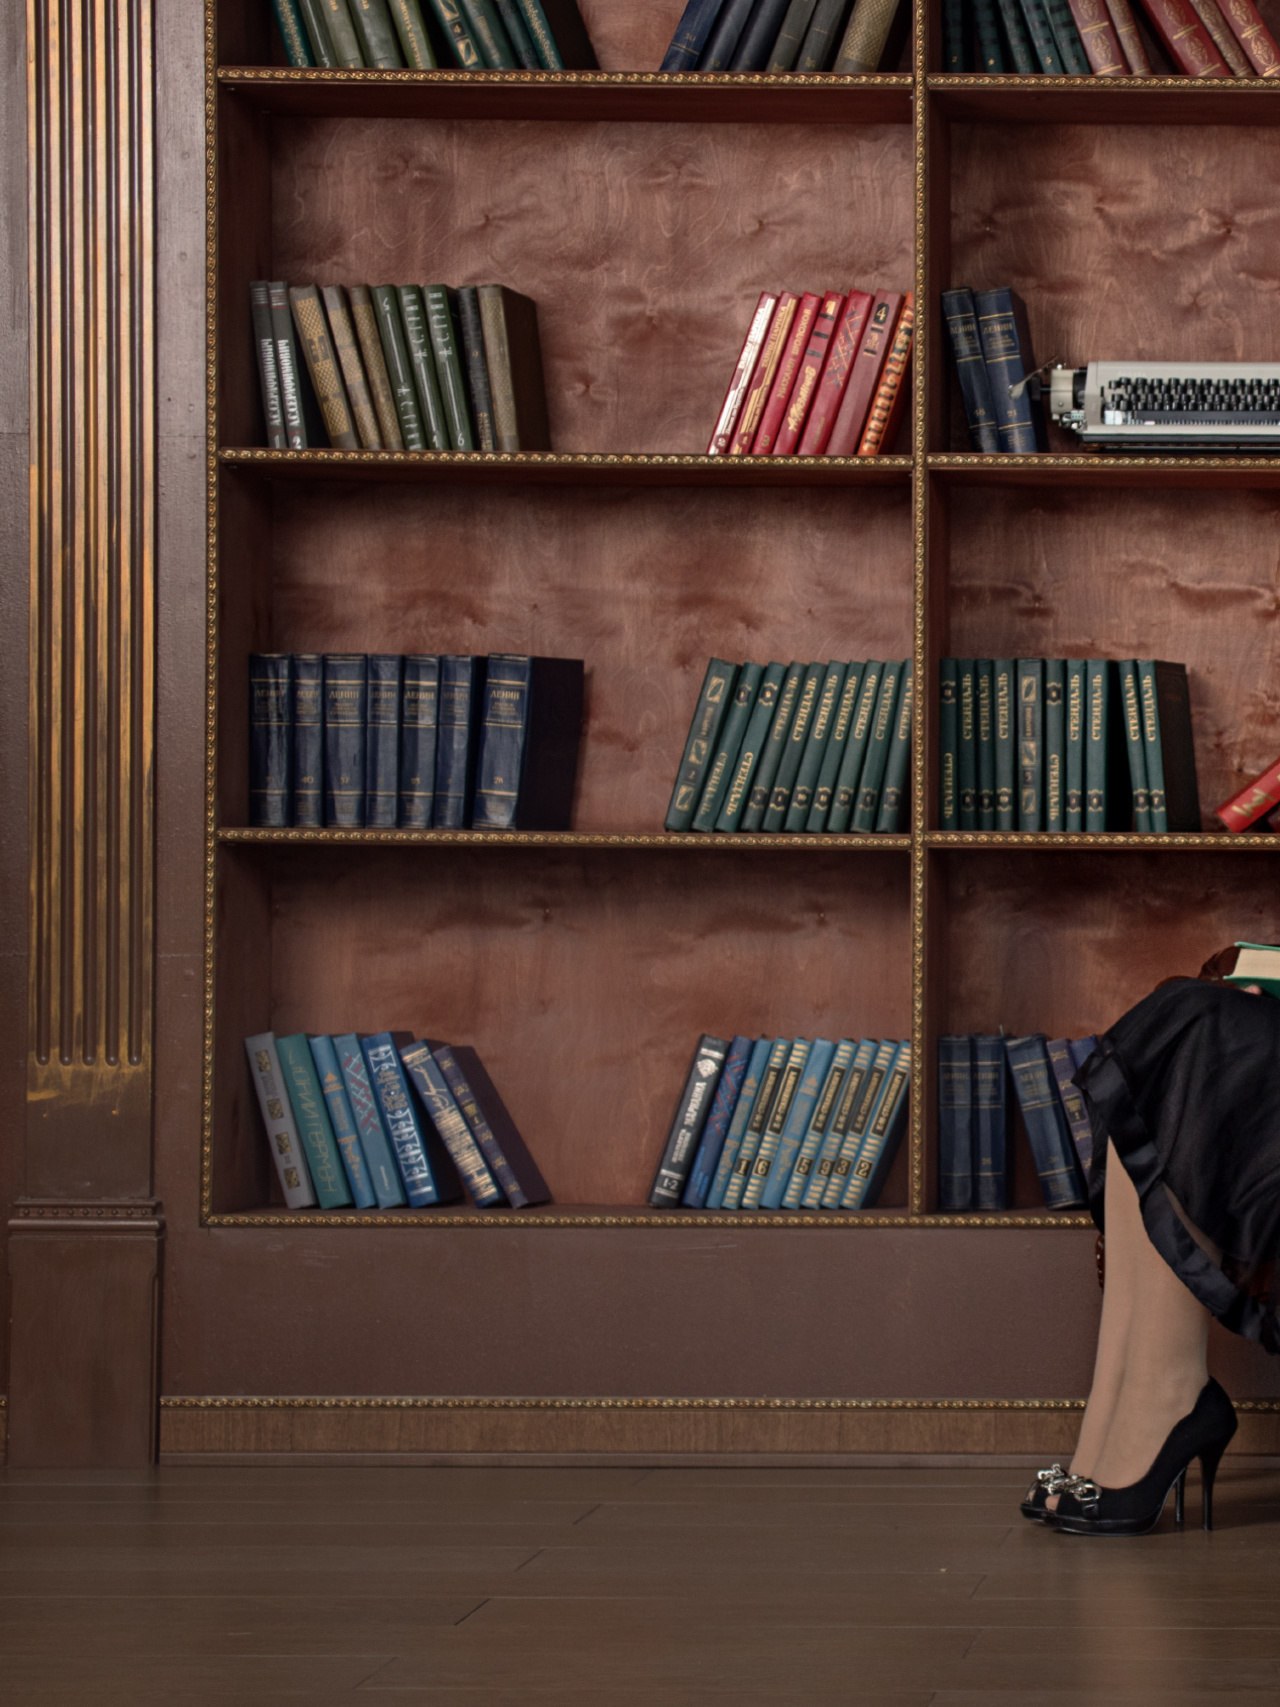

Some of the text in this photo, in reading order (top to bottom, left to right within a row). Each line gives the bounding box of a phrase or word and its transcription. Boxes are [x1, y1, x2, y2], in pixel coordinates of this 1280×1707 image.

[791, 309, 811, 355] ШОЛОХОВ
[877, 306, 886, 321] 4
[292, 435, 301, 449] 2
[457, 433, 464, 446] 6
[329, 690, 360, 700] ЛЕНИН
[405, 691, 435, 701] ЛЕНИН
[490, 691, 520, 700] ЛЕНИН
[773, 676, 798, 740] СТЕНДАЛЬ
[793, 677, 817, 741] СТЕНДАЛЬ
[814, 674, 838, 740] СТЕНДАЛЬ
[834, 675, 857, 741] СТЕНДАЛЬ
[854, 674, 877, 740] СТЕНДАЛЬ
[875, 675, 895, 740] СТЕНДАЛЬ
[962, 673, 972, 741] СТЕНДАЛЬ
[980, 674, 990, 741] СТЕНДАЛЬ
[998, 672, 1009, 739] СТЕНДАЛЬ
[1070, 674, 1080, 741] СТЕНДАЛЬ
[1092, 674, 1102, 741] СТЕНДАЛЬ
[1124, 674, 1140, 741] СТЕНДАЛЬ
[1143, 674, 1156, 742] СТЕНДАЛЬ
[700, 752, 727, 816] СТЕНДАЛЬ
[726, 751, 754, 816] СТЕНДАЛЬ
[943, 752, 953, 819] СТЕНДАЛЬ
[1049, 753, 1059, 821] СТЕНДАЛЬ
[291, 1066, 316, 1119] ЮРИЙ
[663, 1178, 678, 1190] 1-2
[737, 1160, 746, 1174] 1
[756, 1159, 768, 1174] 6
[799, 1159, 809, 1173] 5
[821, 1161, 831, 1176] 9
[837, 1159, 847, 1174] 3
[857, 1161, 868, 1176] 2
